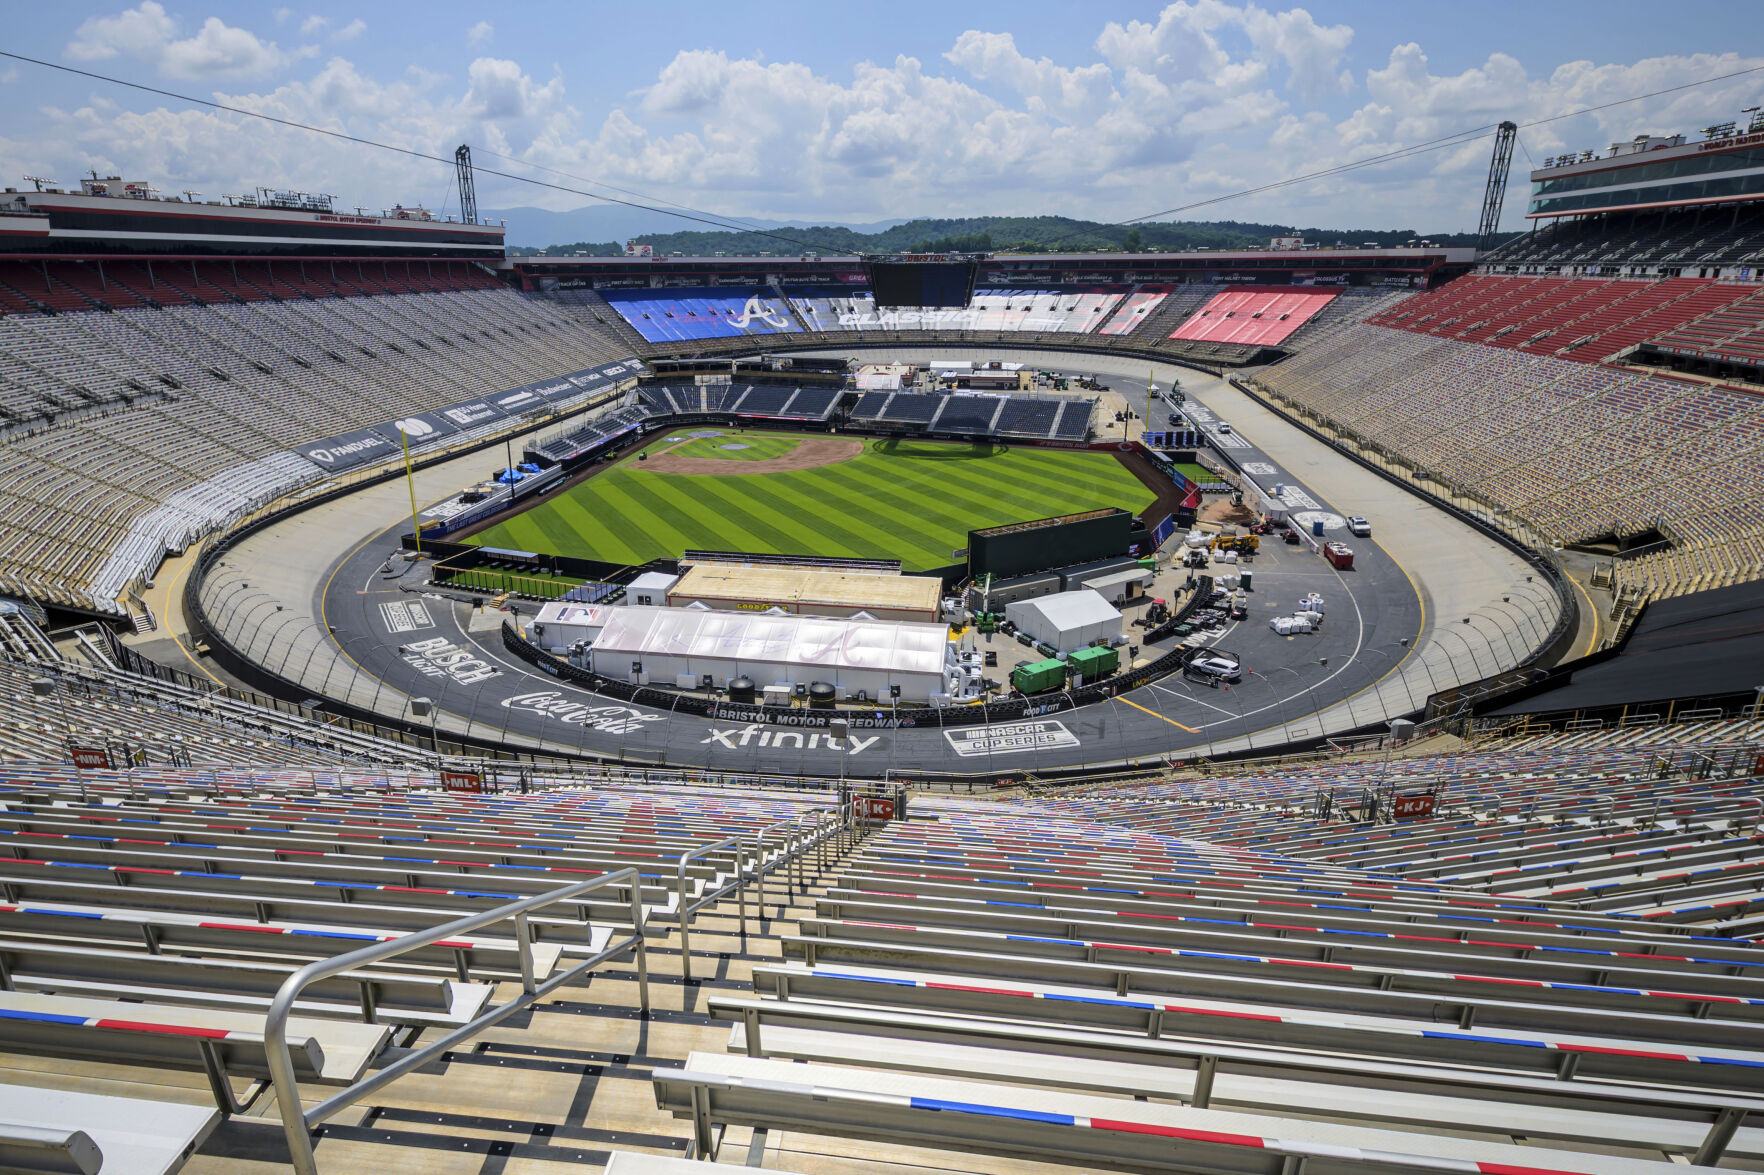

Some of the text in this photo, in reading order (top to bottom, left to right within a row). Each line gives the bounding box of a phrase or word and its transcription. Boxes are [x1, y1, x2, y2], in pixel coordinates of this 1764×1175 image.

[907, 254, 946, 262] BRISTOL
[838, 310, 979, 326] CLASSIC
[330, 437, 385, 457] FANDUEL
[403, 636, 505, 686] BUSCH
[403, 654, 447, 679] LIGHT
[1023, 707, 1040, 717] FOOD
[1047, 702, 1061, 712] CITY
[719, 708, 903, 729] BRISTOL MOTOR EEDWAY
[982, 724, 1046, 739] NASCAR
[972, 734, 1056, 750] CUP SERIES
[78, 754, 102, 765] NM
[450, 777, 473, 789] ML
[1403, 800, 1425, 814] KJ
